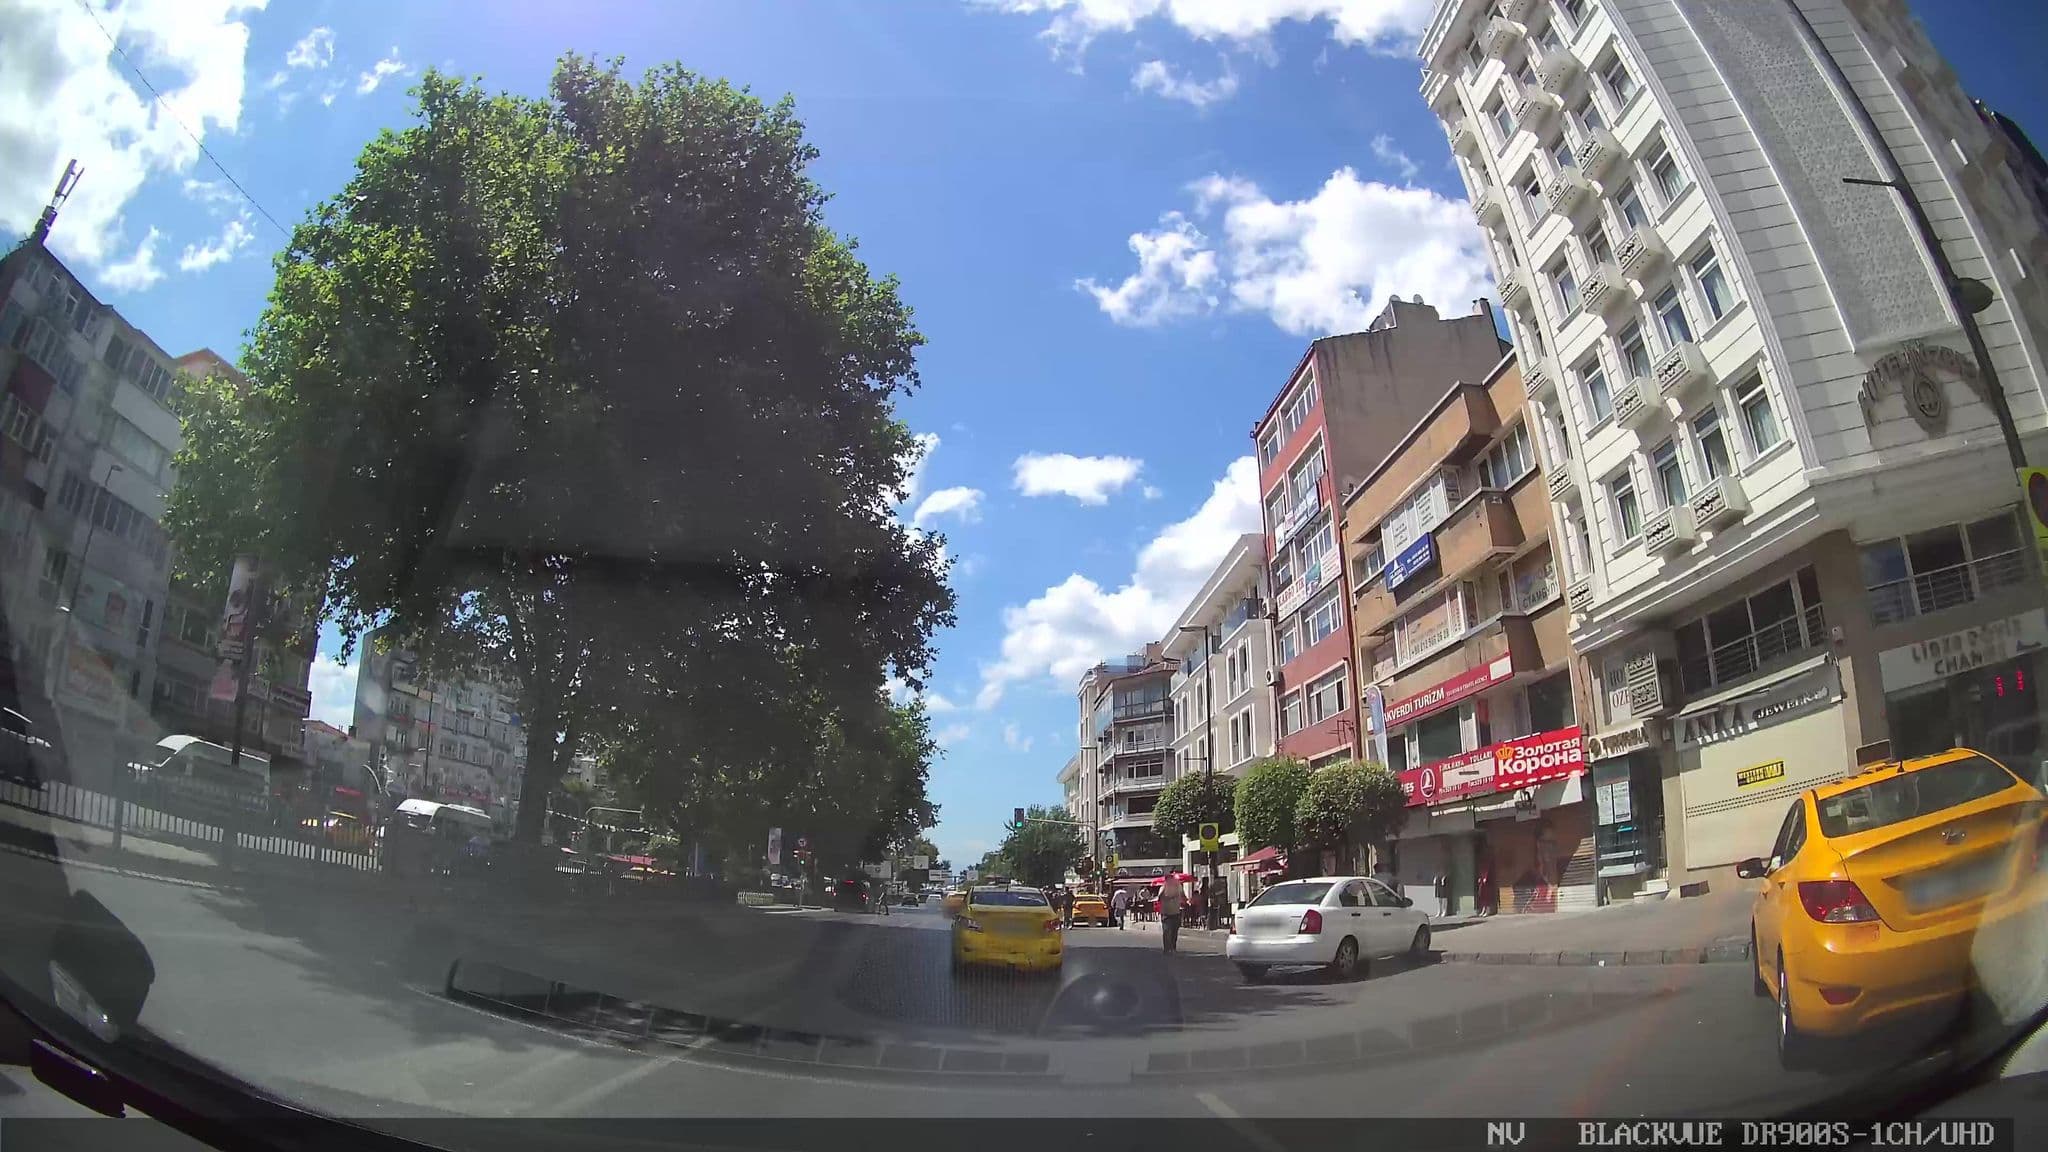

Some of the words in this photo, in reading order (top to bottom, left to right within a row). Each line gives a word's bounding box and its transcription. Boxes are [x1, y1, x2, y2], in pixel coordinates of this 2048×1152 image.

[1413, 687, 1445, 710] TURİZM
[1514, 737, 1580, 759] Золотая
[1498, 748, 1582, 776] Корона
